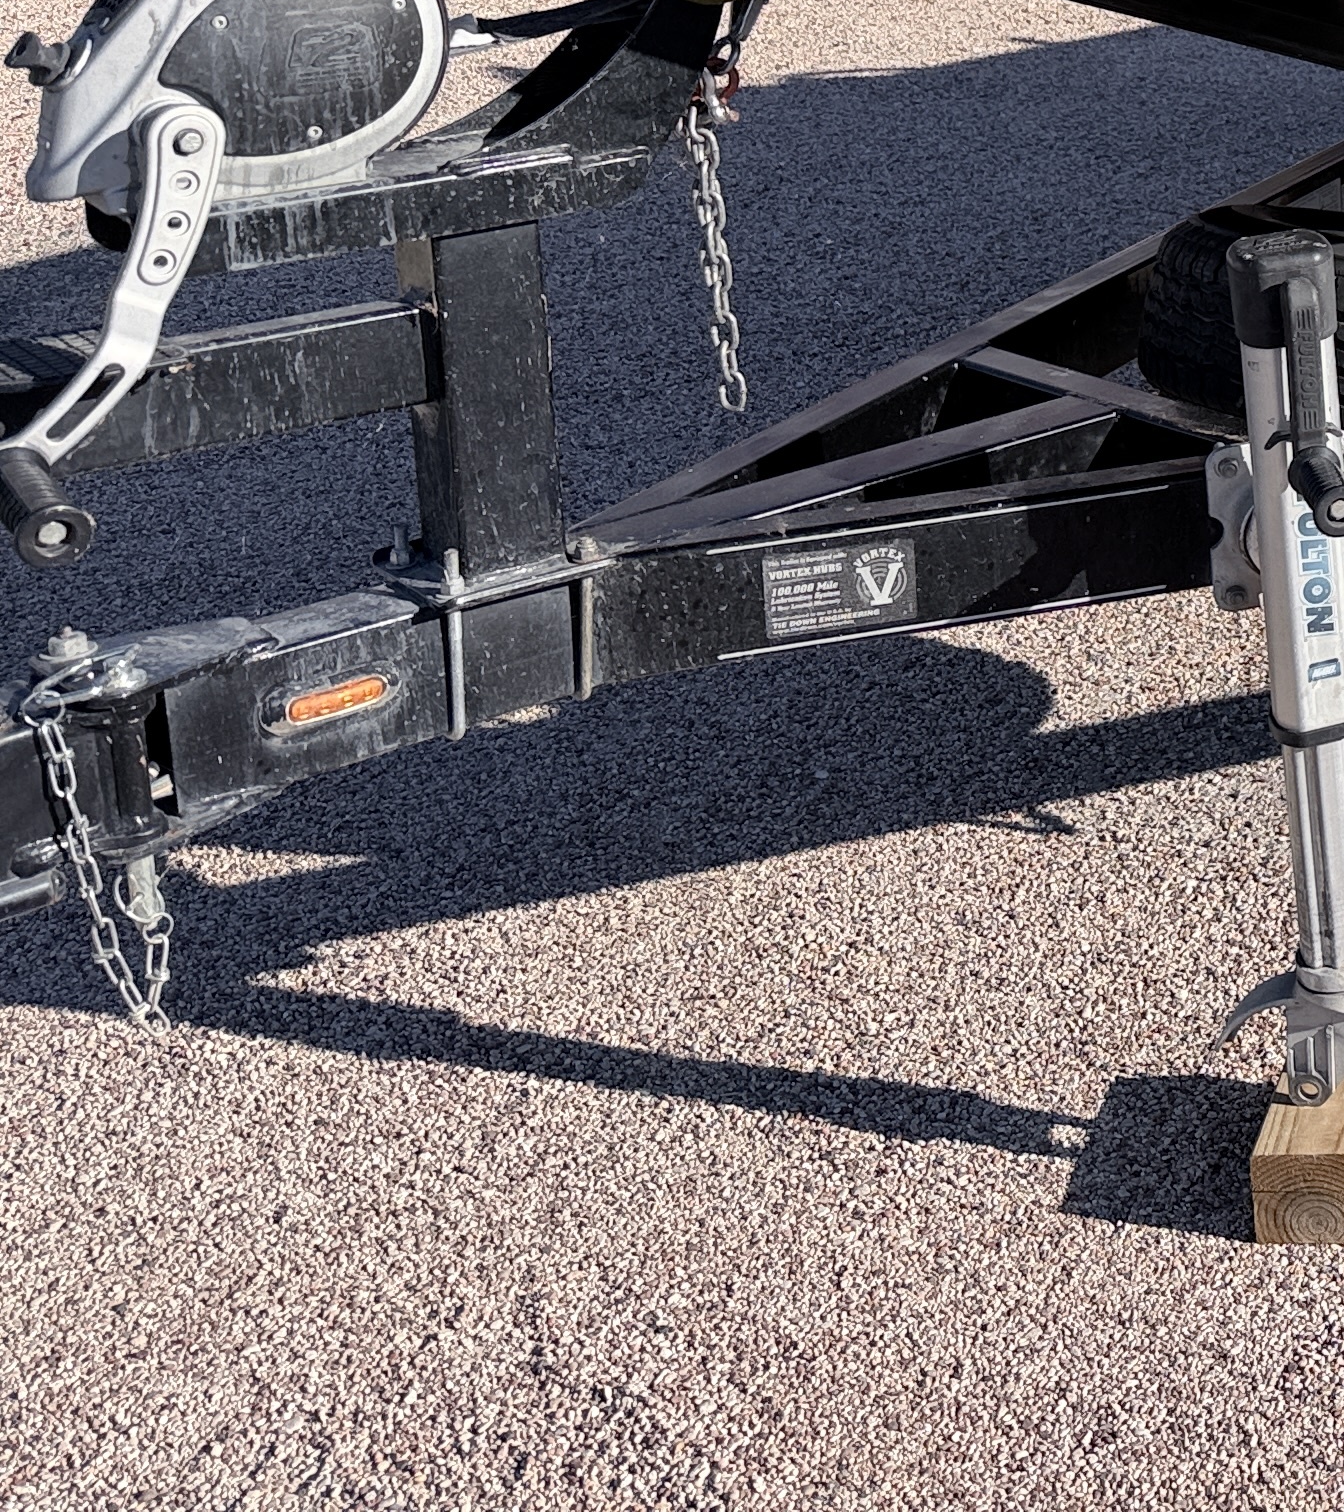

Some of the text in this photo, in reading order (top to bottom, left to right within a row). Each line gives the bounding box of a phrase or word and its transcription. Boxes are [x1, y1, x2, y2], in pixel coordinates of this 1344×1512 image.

[1296, 330, 1320, 409] FULTON
[853, 547, 906, 567] VORTEX
[1296, 496, 1336, 634] ULTON
[768, 563, 843, 581] VORTEX HUBS
[815, 580, 839, 591] Mile
[855, 561, 904, 607] V
[789, 618, 817, 628] DOWN
